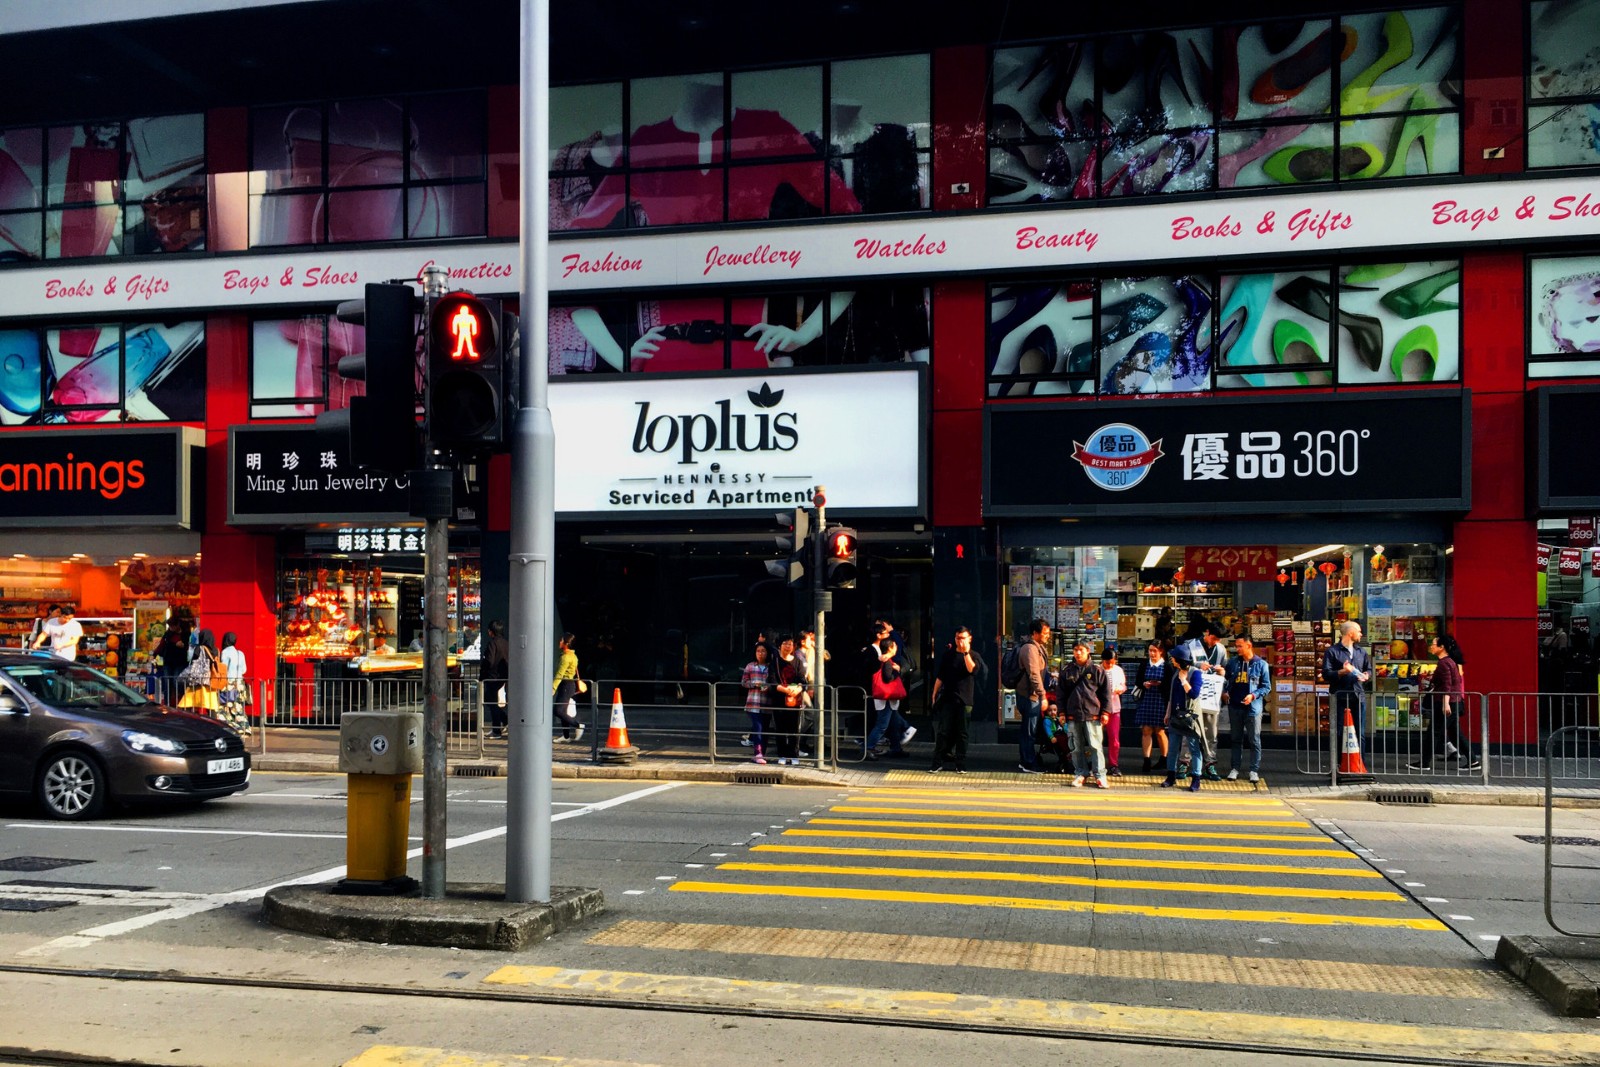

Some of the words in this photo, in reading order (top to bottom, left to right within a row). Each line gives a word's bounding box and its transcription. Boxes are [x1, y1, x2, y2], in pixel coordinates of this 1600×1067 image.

[1432, 200, 1500, 231] Bags
[1515, 195, 1536, 220] &
[1171, 215, 1242, 240] Books
[1256, 210, 1276, 234] &
[1287, 208, 1353, 241] Gifts
[853, 233, 948, 260] Watches
[1016, 226, 1099, 252] Beauty
[561, 251, 643, 279] Fashion
[703, 244, 802, 276] Jewellery
[45, 278, 93, 299] Books
[103, 275, 117, 295] &
[125, 274, 169, 301] Gifts
[223, 269, 269, 295] Bags
[279, 266, 294, 286] &
[302, 265, 359, 287] Shoes
[1099, 434, 1136, 452] 優品
[1091, 458, 1107, 467] BEST
[1109, 460, 1127, 468] MART
[246, 475, 286, 493] Ming
[291, 474, 319, 491] Jun
[324, 474, 389, 492] Jewelry
[664, 473, 766, 484] HENNESSY
[1106, 471, 1130, 486] 360°
[609, 490, 695, 505] Serviced
[706, 488, 813, 507] Apartment
[1570, 530, 1593, 539] $699
[1559, 561, 1581, 570] $699
